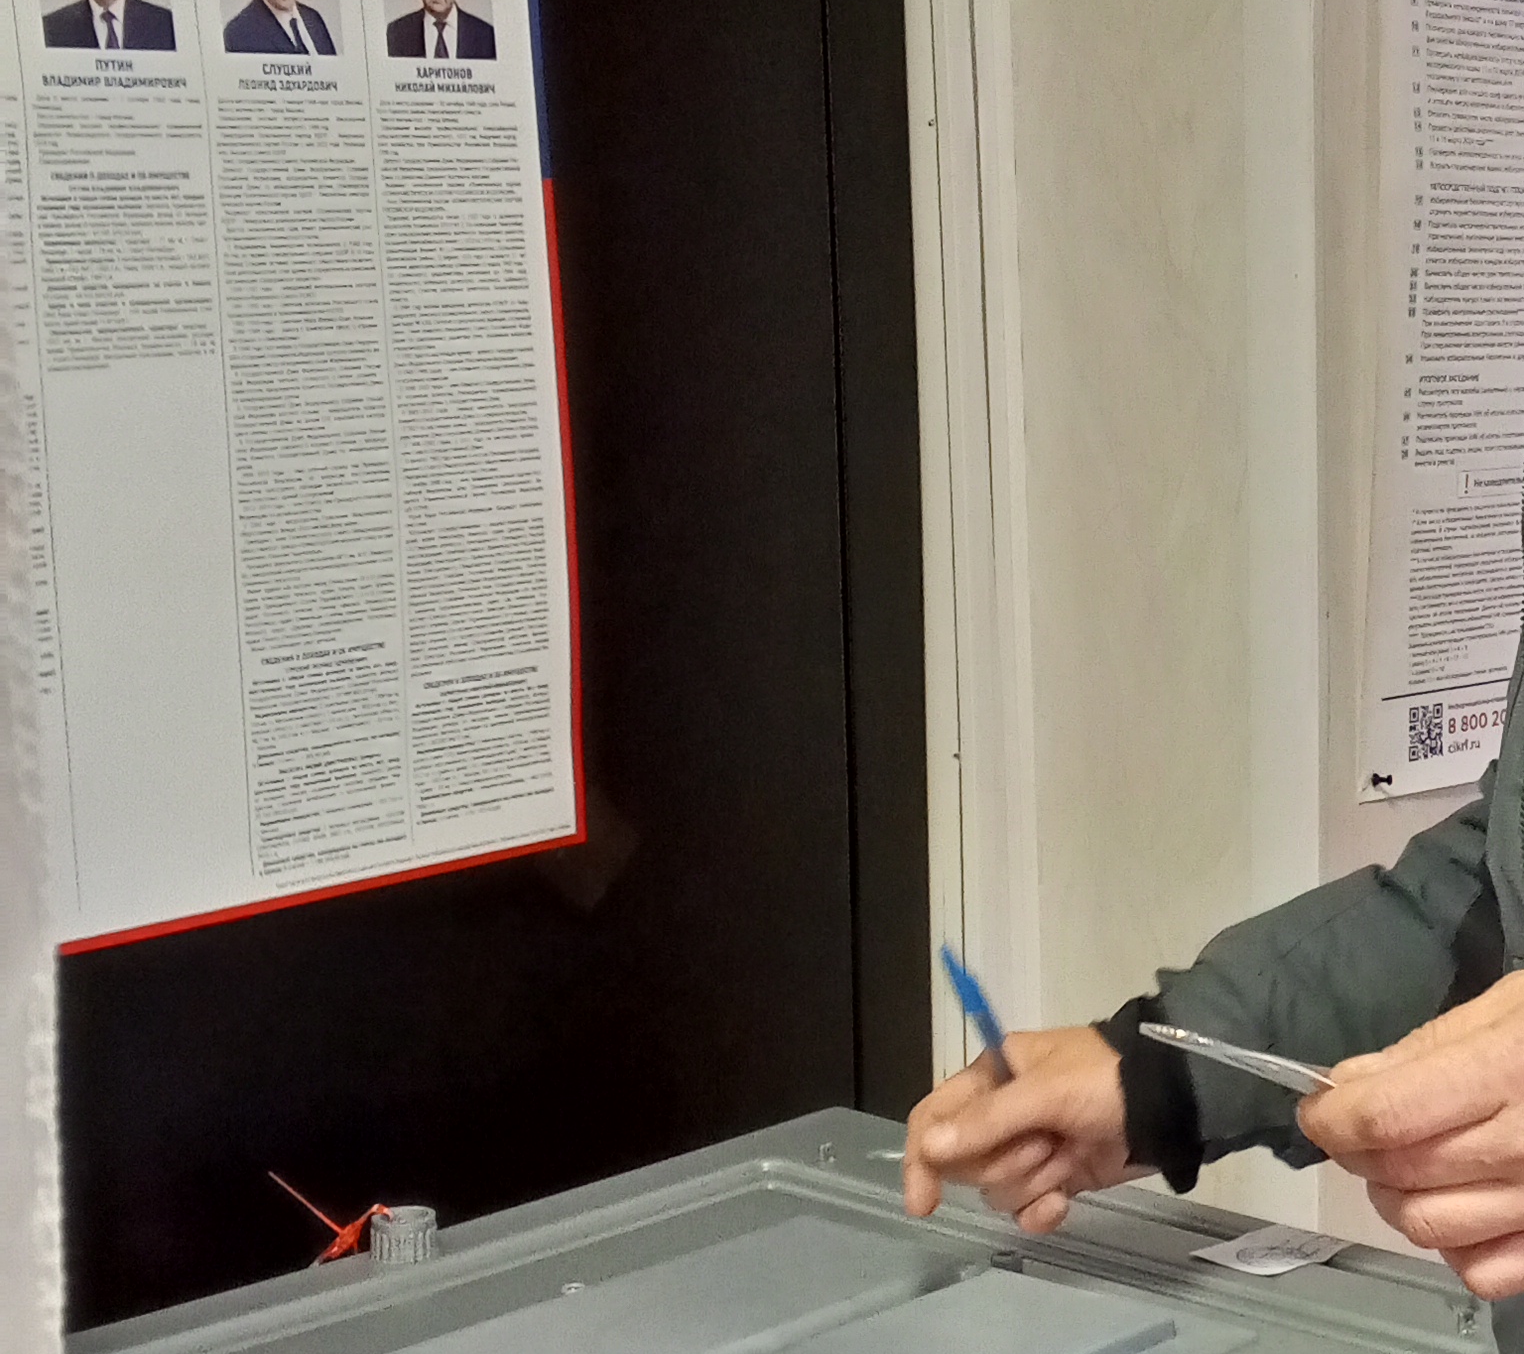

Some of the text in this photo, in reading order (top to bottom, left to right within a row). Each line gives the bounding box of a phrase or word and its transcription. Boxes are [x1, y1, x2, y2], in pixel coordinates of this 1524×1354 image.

[95, 58, 134, 72] ПУТИН
[262, 61, 313, 77] СЛУЦКИЙ
[415, 66, 473, 80] ХАРИТОНОВ
[42, 74, 188, 89] ВЛАДИМИР ВЛАДИМИРОВИЧ
[395, 81, 496, 95] НИКОЛАЙ МИХАЙЛОВИЧ
[1448, 717, 1456, 734] 8
[1461, 712, 1488, 732] 800
